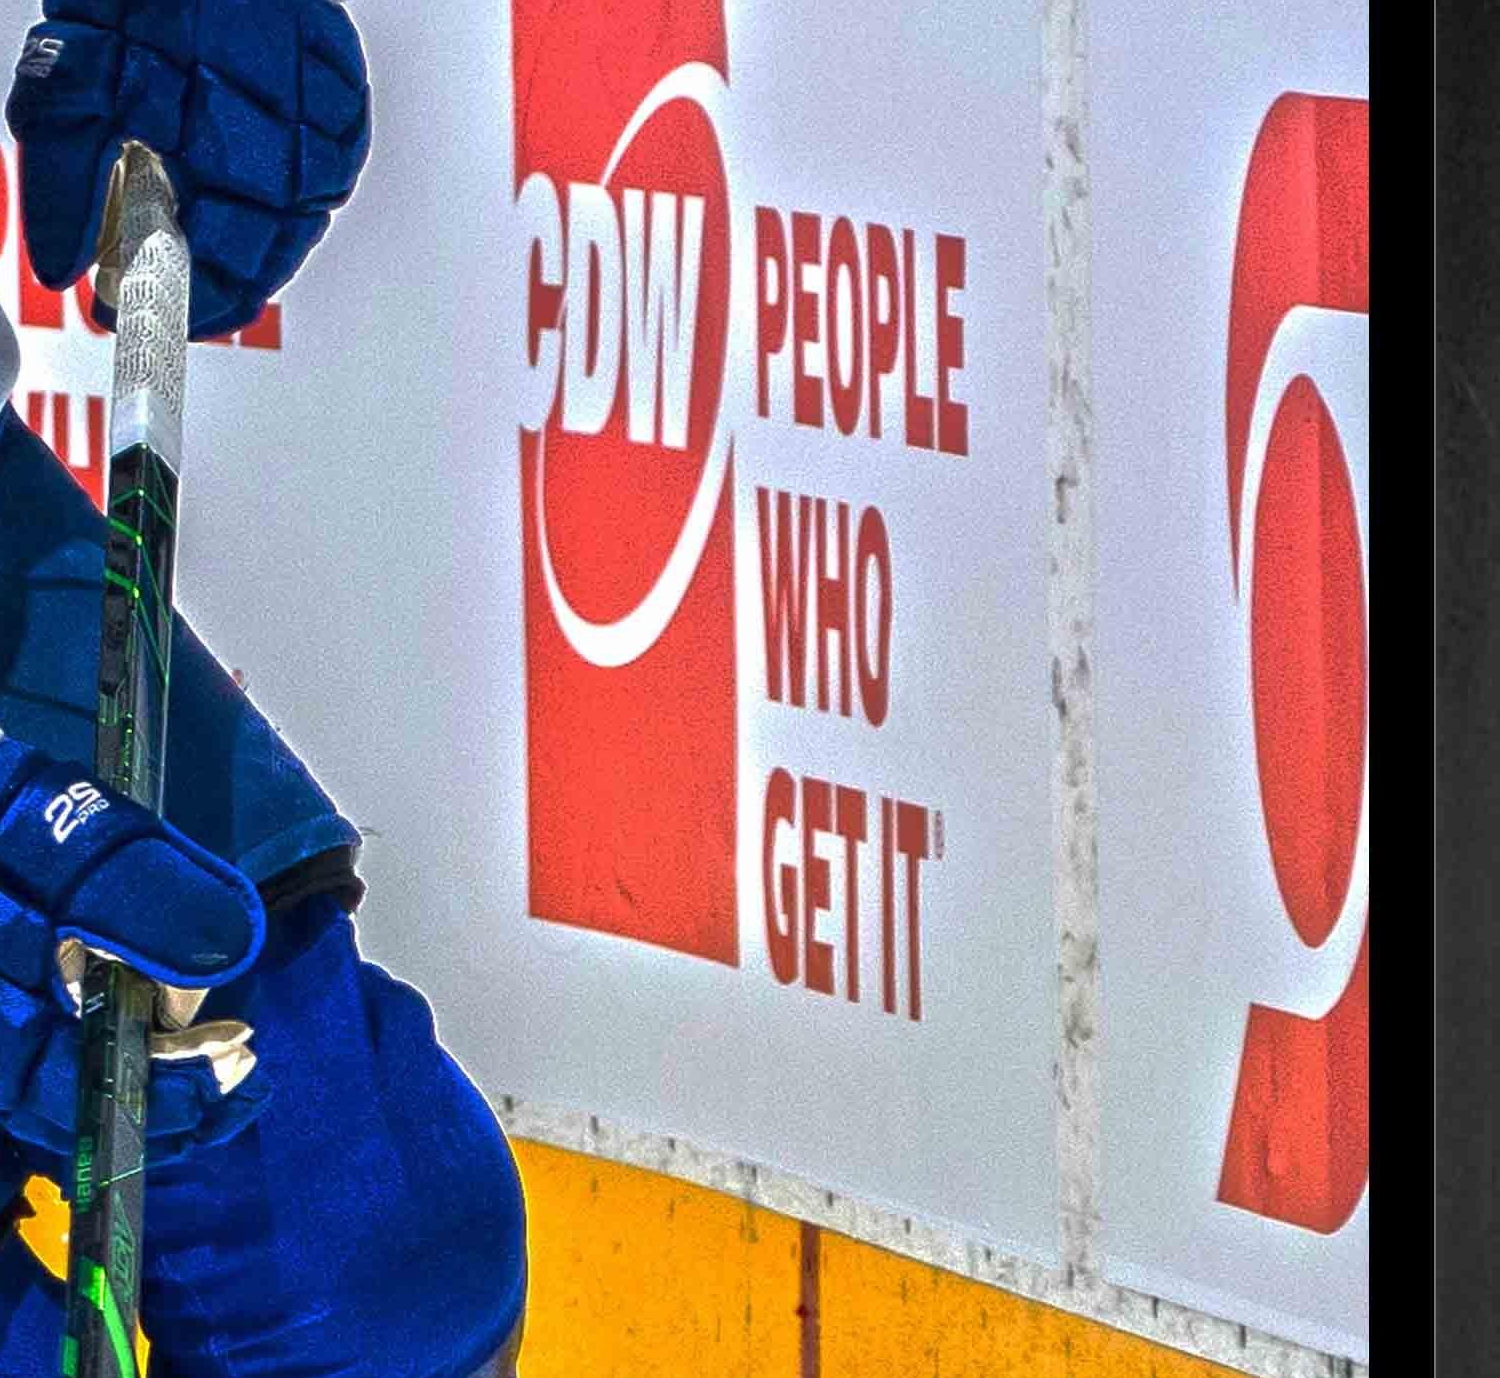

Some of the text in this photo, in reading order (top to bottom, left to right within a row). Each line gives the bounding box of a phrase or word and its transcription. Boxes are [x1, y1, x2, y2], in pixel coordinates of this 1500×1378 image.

[514, 171, 705, 451] CDW
[753, 204, 969, 458] PEOPLE
[755, 485, 893, 729] WHO
[77, 798, 110, 825] PRO
[761, 766, 930, 1023] GET IT
